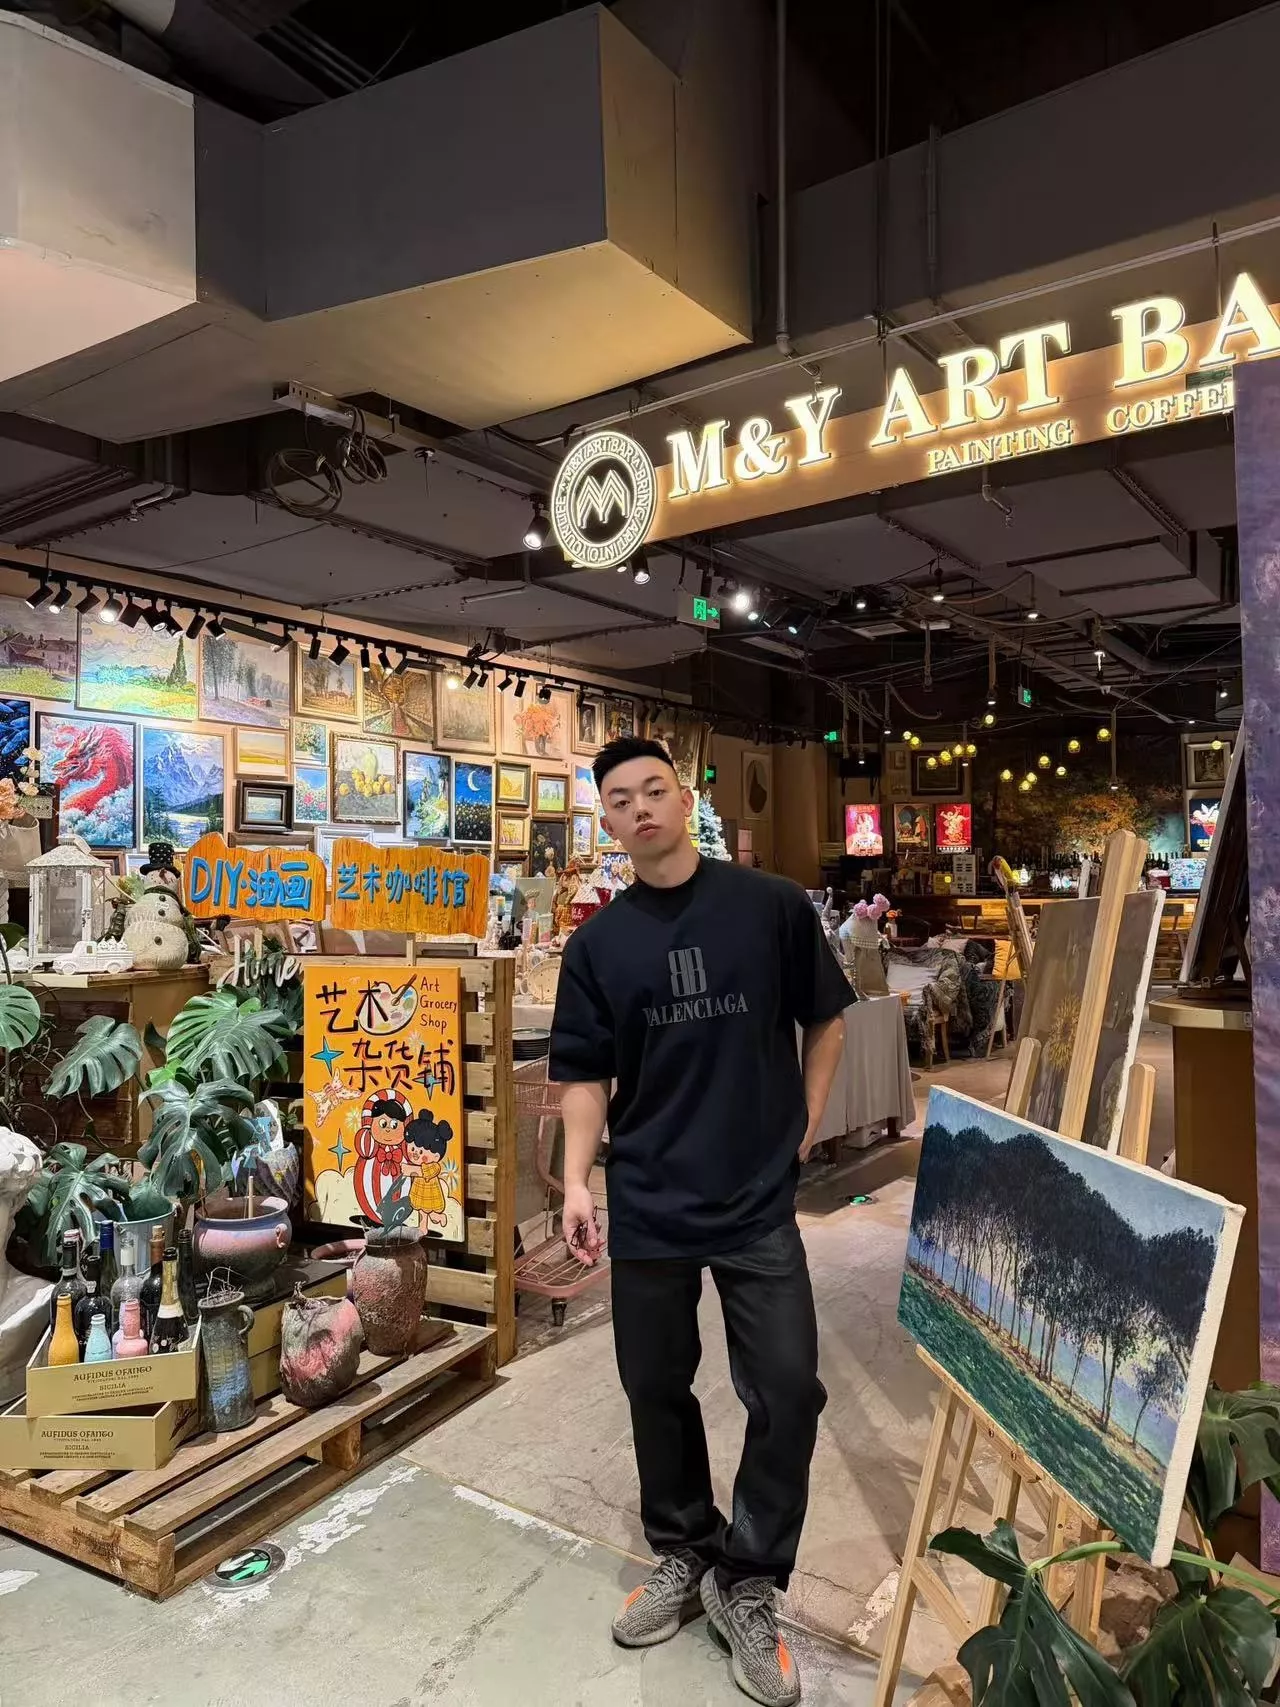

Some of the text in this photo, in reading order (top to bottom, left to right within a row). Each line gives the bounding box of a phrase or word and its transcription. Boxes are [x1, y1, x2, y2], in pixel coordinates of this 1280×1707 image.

[665, 385, 843, 500] M&Y
[869, 319, 1071, 448] ART
[926, 418, 1074, 476] PAINTING
[337, 863, 469, 908] 艺术咖啡馆
[315, 980, 389, 1033] 艺术
[420, 976, 440, 992] Art
[420, 995, 458, 1014] Grocery
[420, 1013, 448, 1032] Shop
[343, 1037, 456, 1096] 杂货铺
